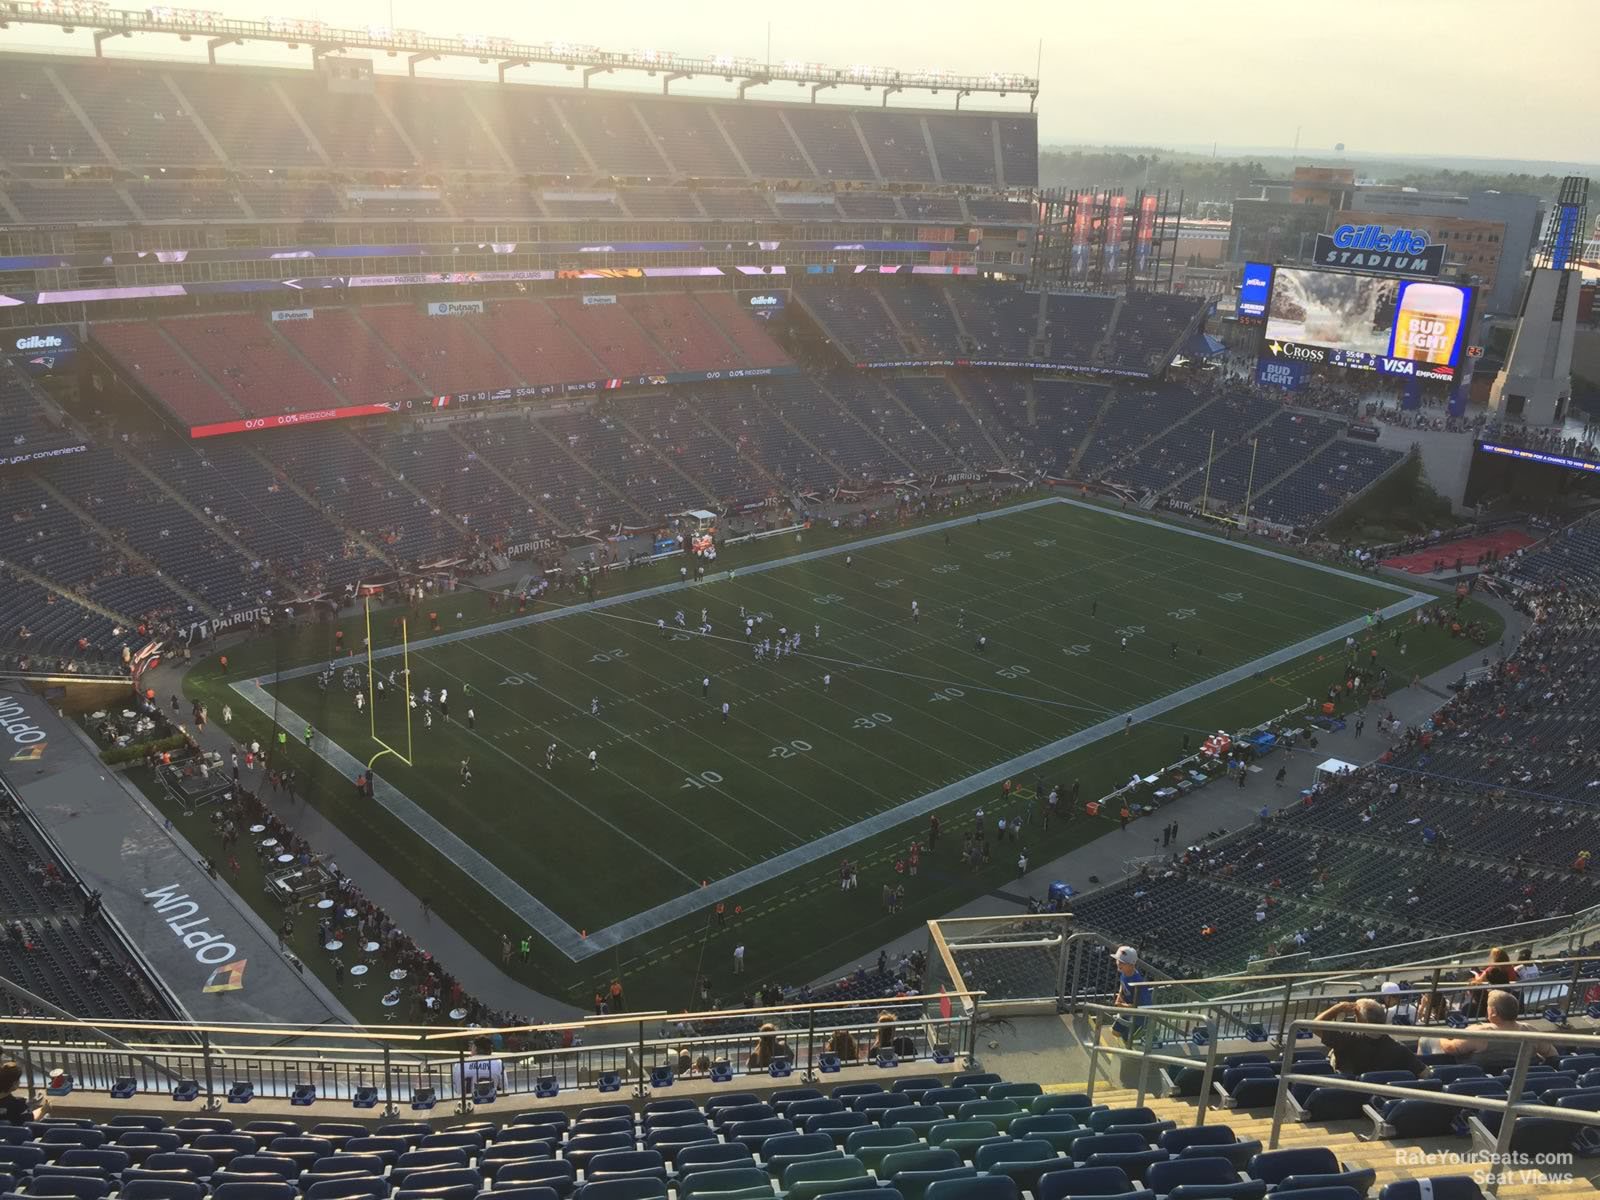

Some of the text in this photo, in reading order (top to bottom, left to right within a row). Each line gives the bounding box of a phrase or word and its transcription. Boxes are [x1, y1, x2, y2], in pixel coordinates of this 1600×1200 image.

[1333, 224, 1426, 255] Gillette
[1326, 251, 1428, 271] STADIUM
[448, 303, 480, 312] Putnam
[1408, 319, 1445, 336] BUD
[16, 336, 62, 349] Gillette
[1401, 331, 1448, 349] LIGHT
[1266, 364, 1291, 376] BUD
[1382, 358, 1414, 375] VISA
[1261, 372, 1293, 385] LIGHT
[1416, 370, 1453, 381] EMPOWER
[245, 409, 337, 429] 0/0 0.0% REDZONE
[10, 454, 31, 465] your
[948, 472, 981, 484] PATRIOTS
[508, 538, 551, 558] PATRIOTS
[212, 606, 269, 633] PATRIOTS
[592, 648, 629, 662] 20
[996, 664, 1030, 679] 50
[933, 687, 965, 702] 40
[854, 712, 893, 729] 30
[772, 739, 812, 759] 20
[684, 770, 723, 789] 10
[144, 883, 236, 964] OPTUM
